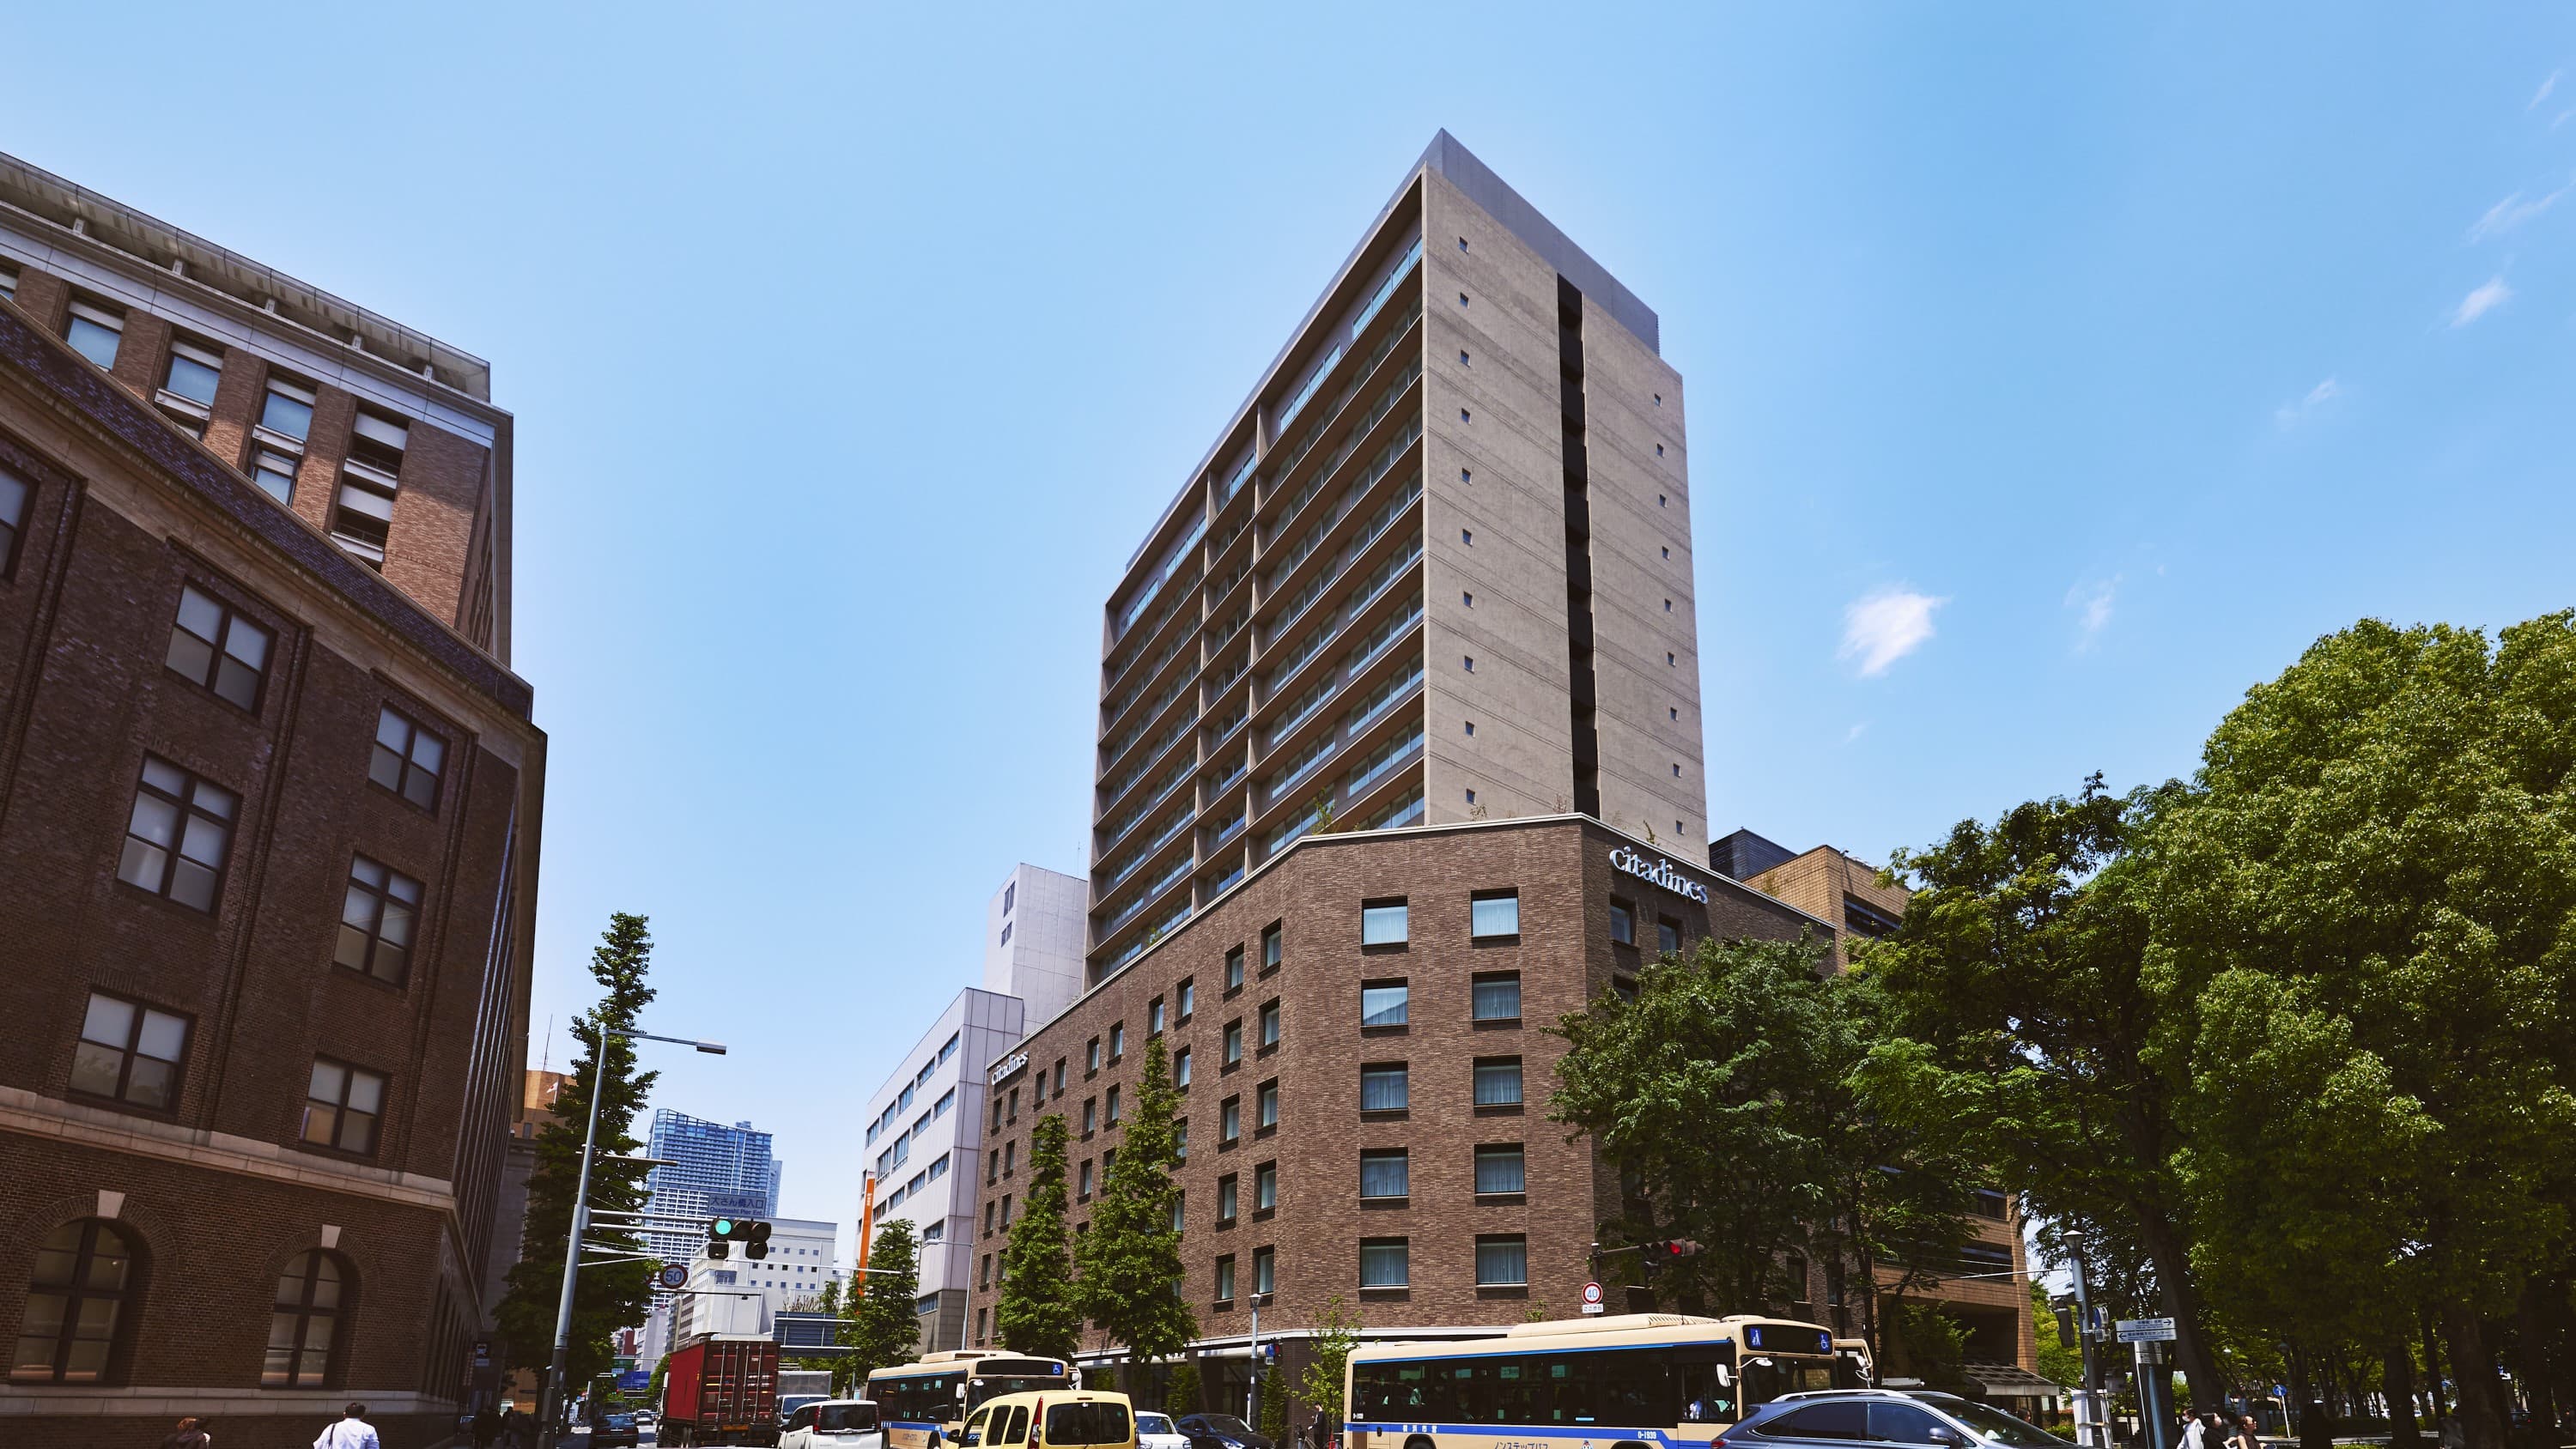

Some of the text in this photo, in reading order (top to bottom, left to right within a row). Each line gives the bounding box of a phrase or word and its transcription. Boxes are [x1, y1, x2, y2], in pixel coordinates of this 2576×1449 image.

[1609, 846, 1709, 905] citadines
[710, 1195, 764, 1209] 大さん橋入口
[665, 1270, 682, 1282] 50
[1587, 1288, 1598, 1298] 40
